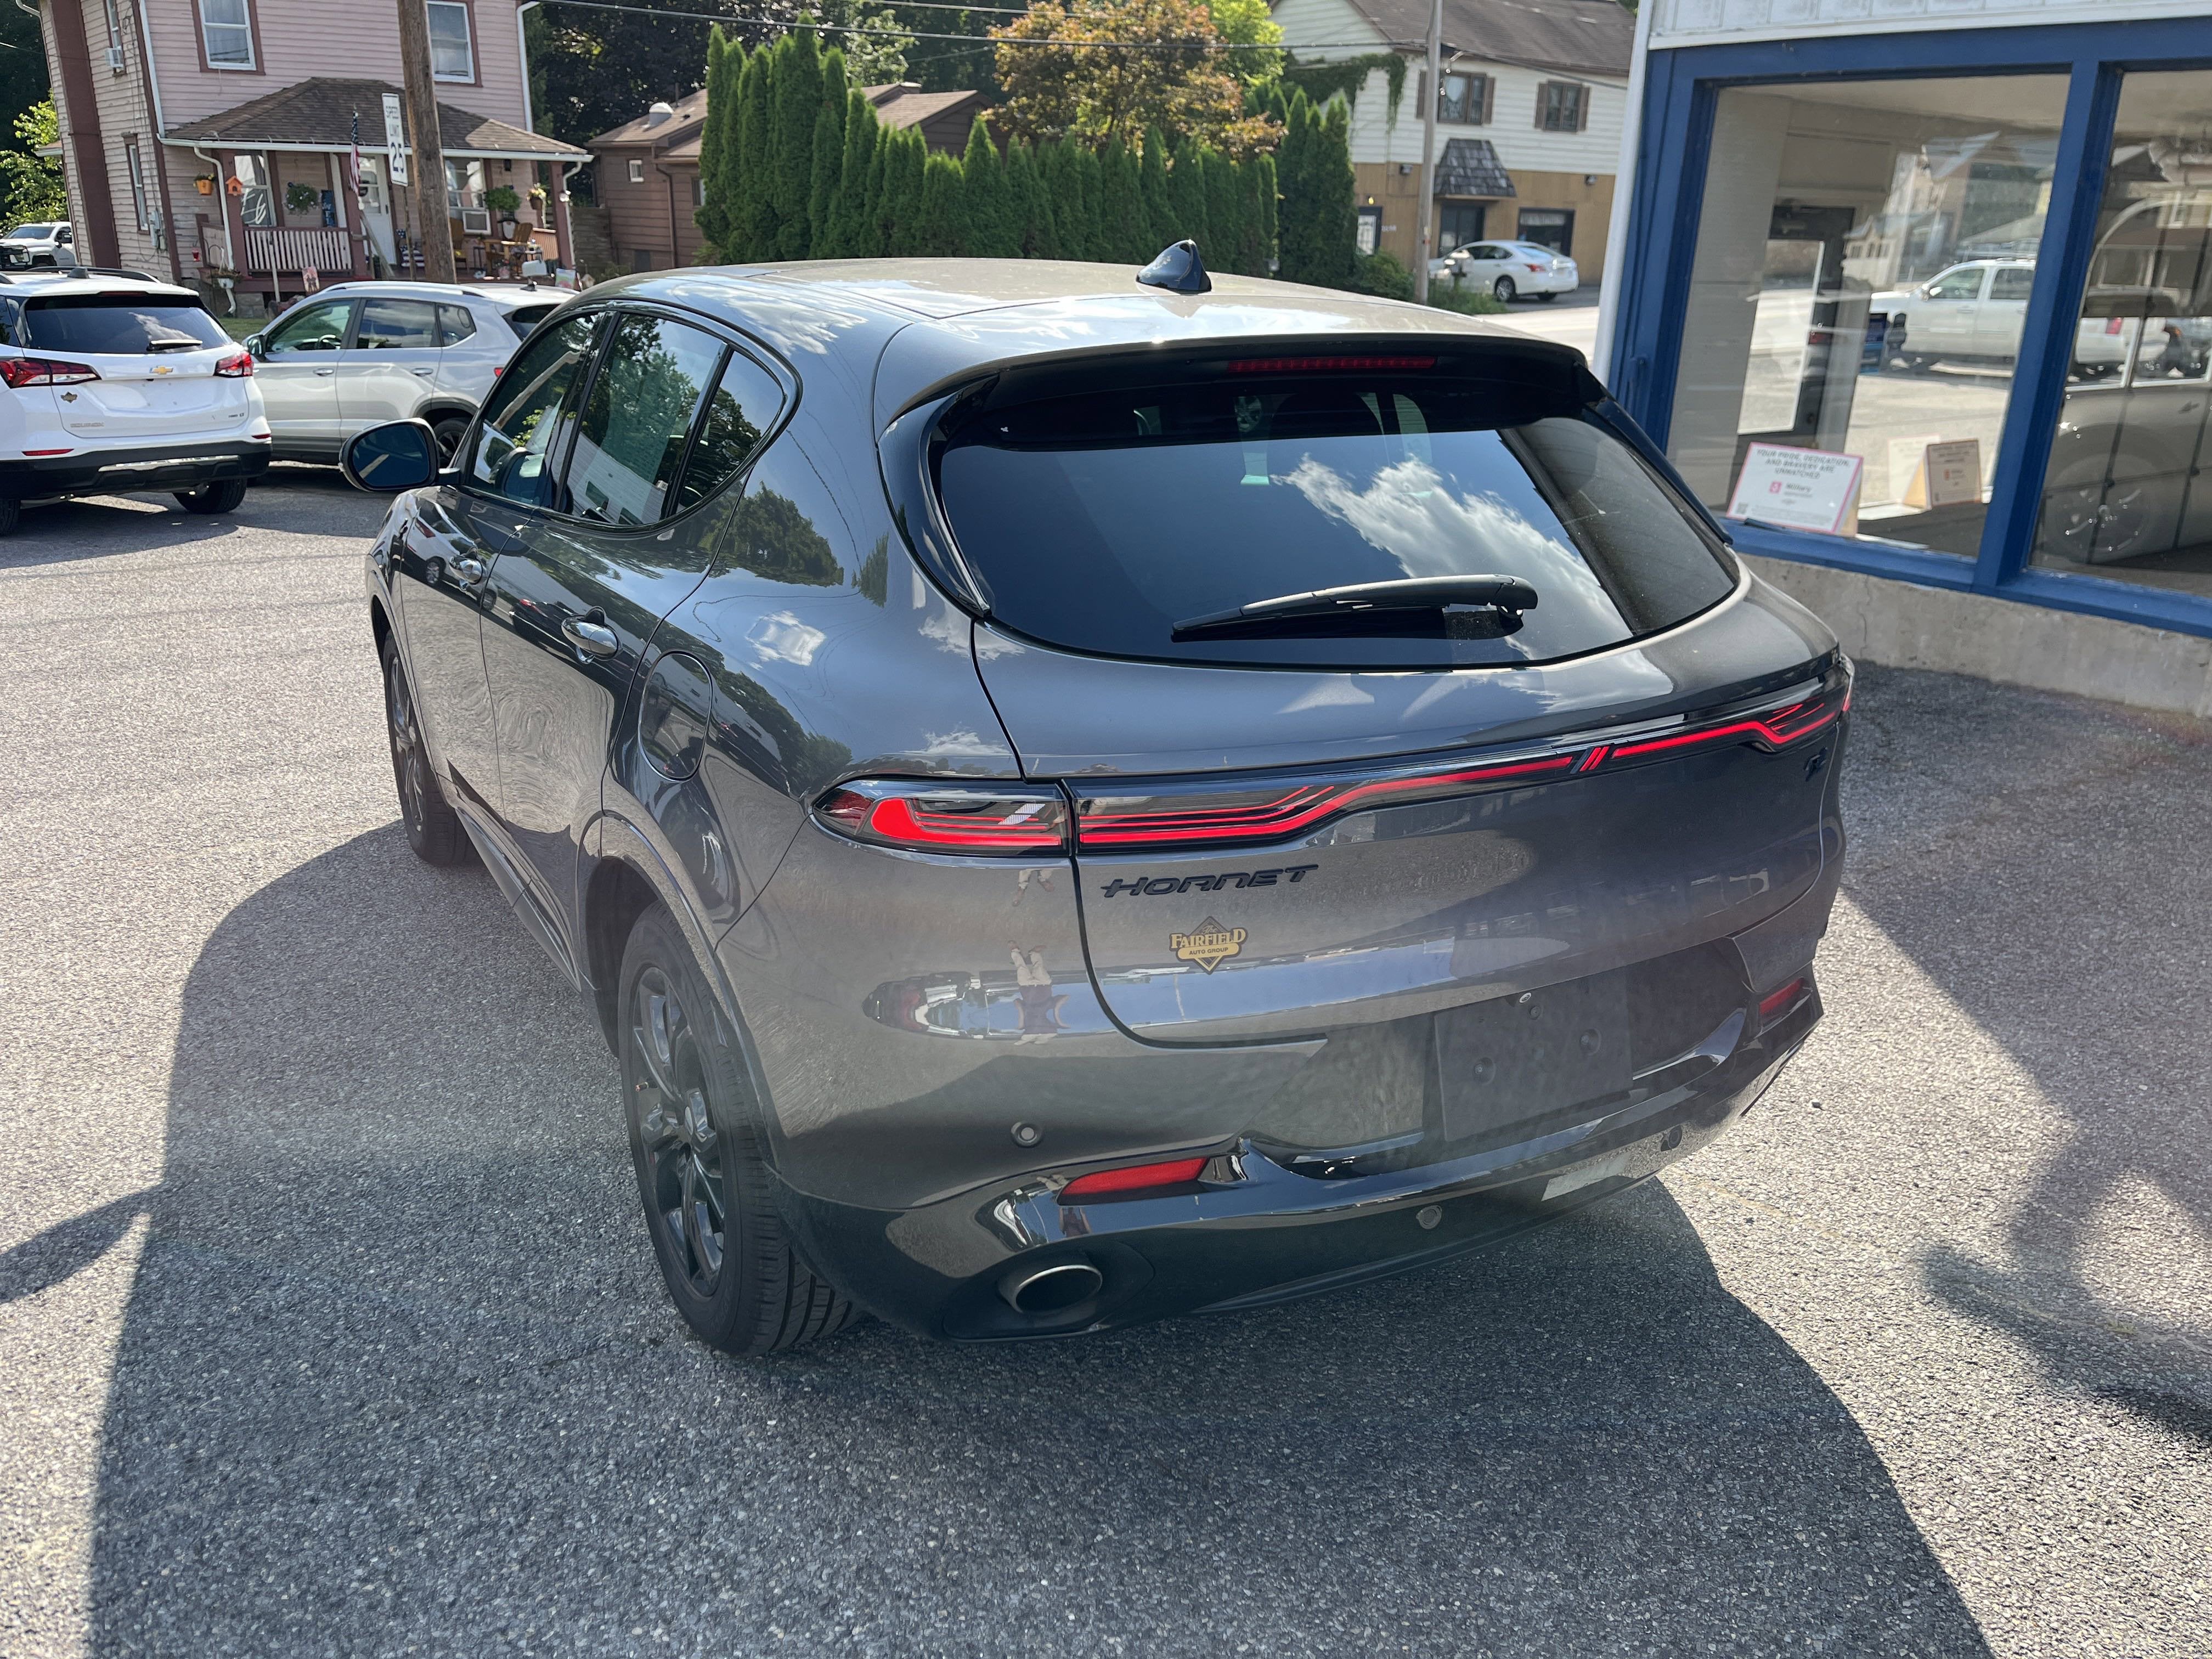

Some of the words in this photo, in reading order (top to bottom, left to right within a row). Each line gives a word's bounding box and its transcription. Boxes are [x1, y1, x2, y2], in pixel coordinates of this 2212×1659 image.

[391, 142, 404, 174] 25
[1757, 448, 1776, 456] YOUR
[1819, 465, 1835, 473] ARE
[1101, 864, 1319, 898] HORNET
[1170, 928, 1246, 949] FAIRFIELD
